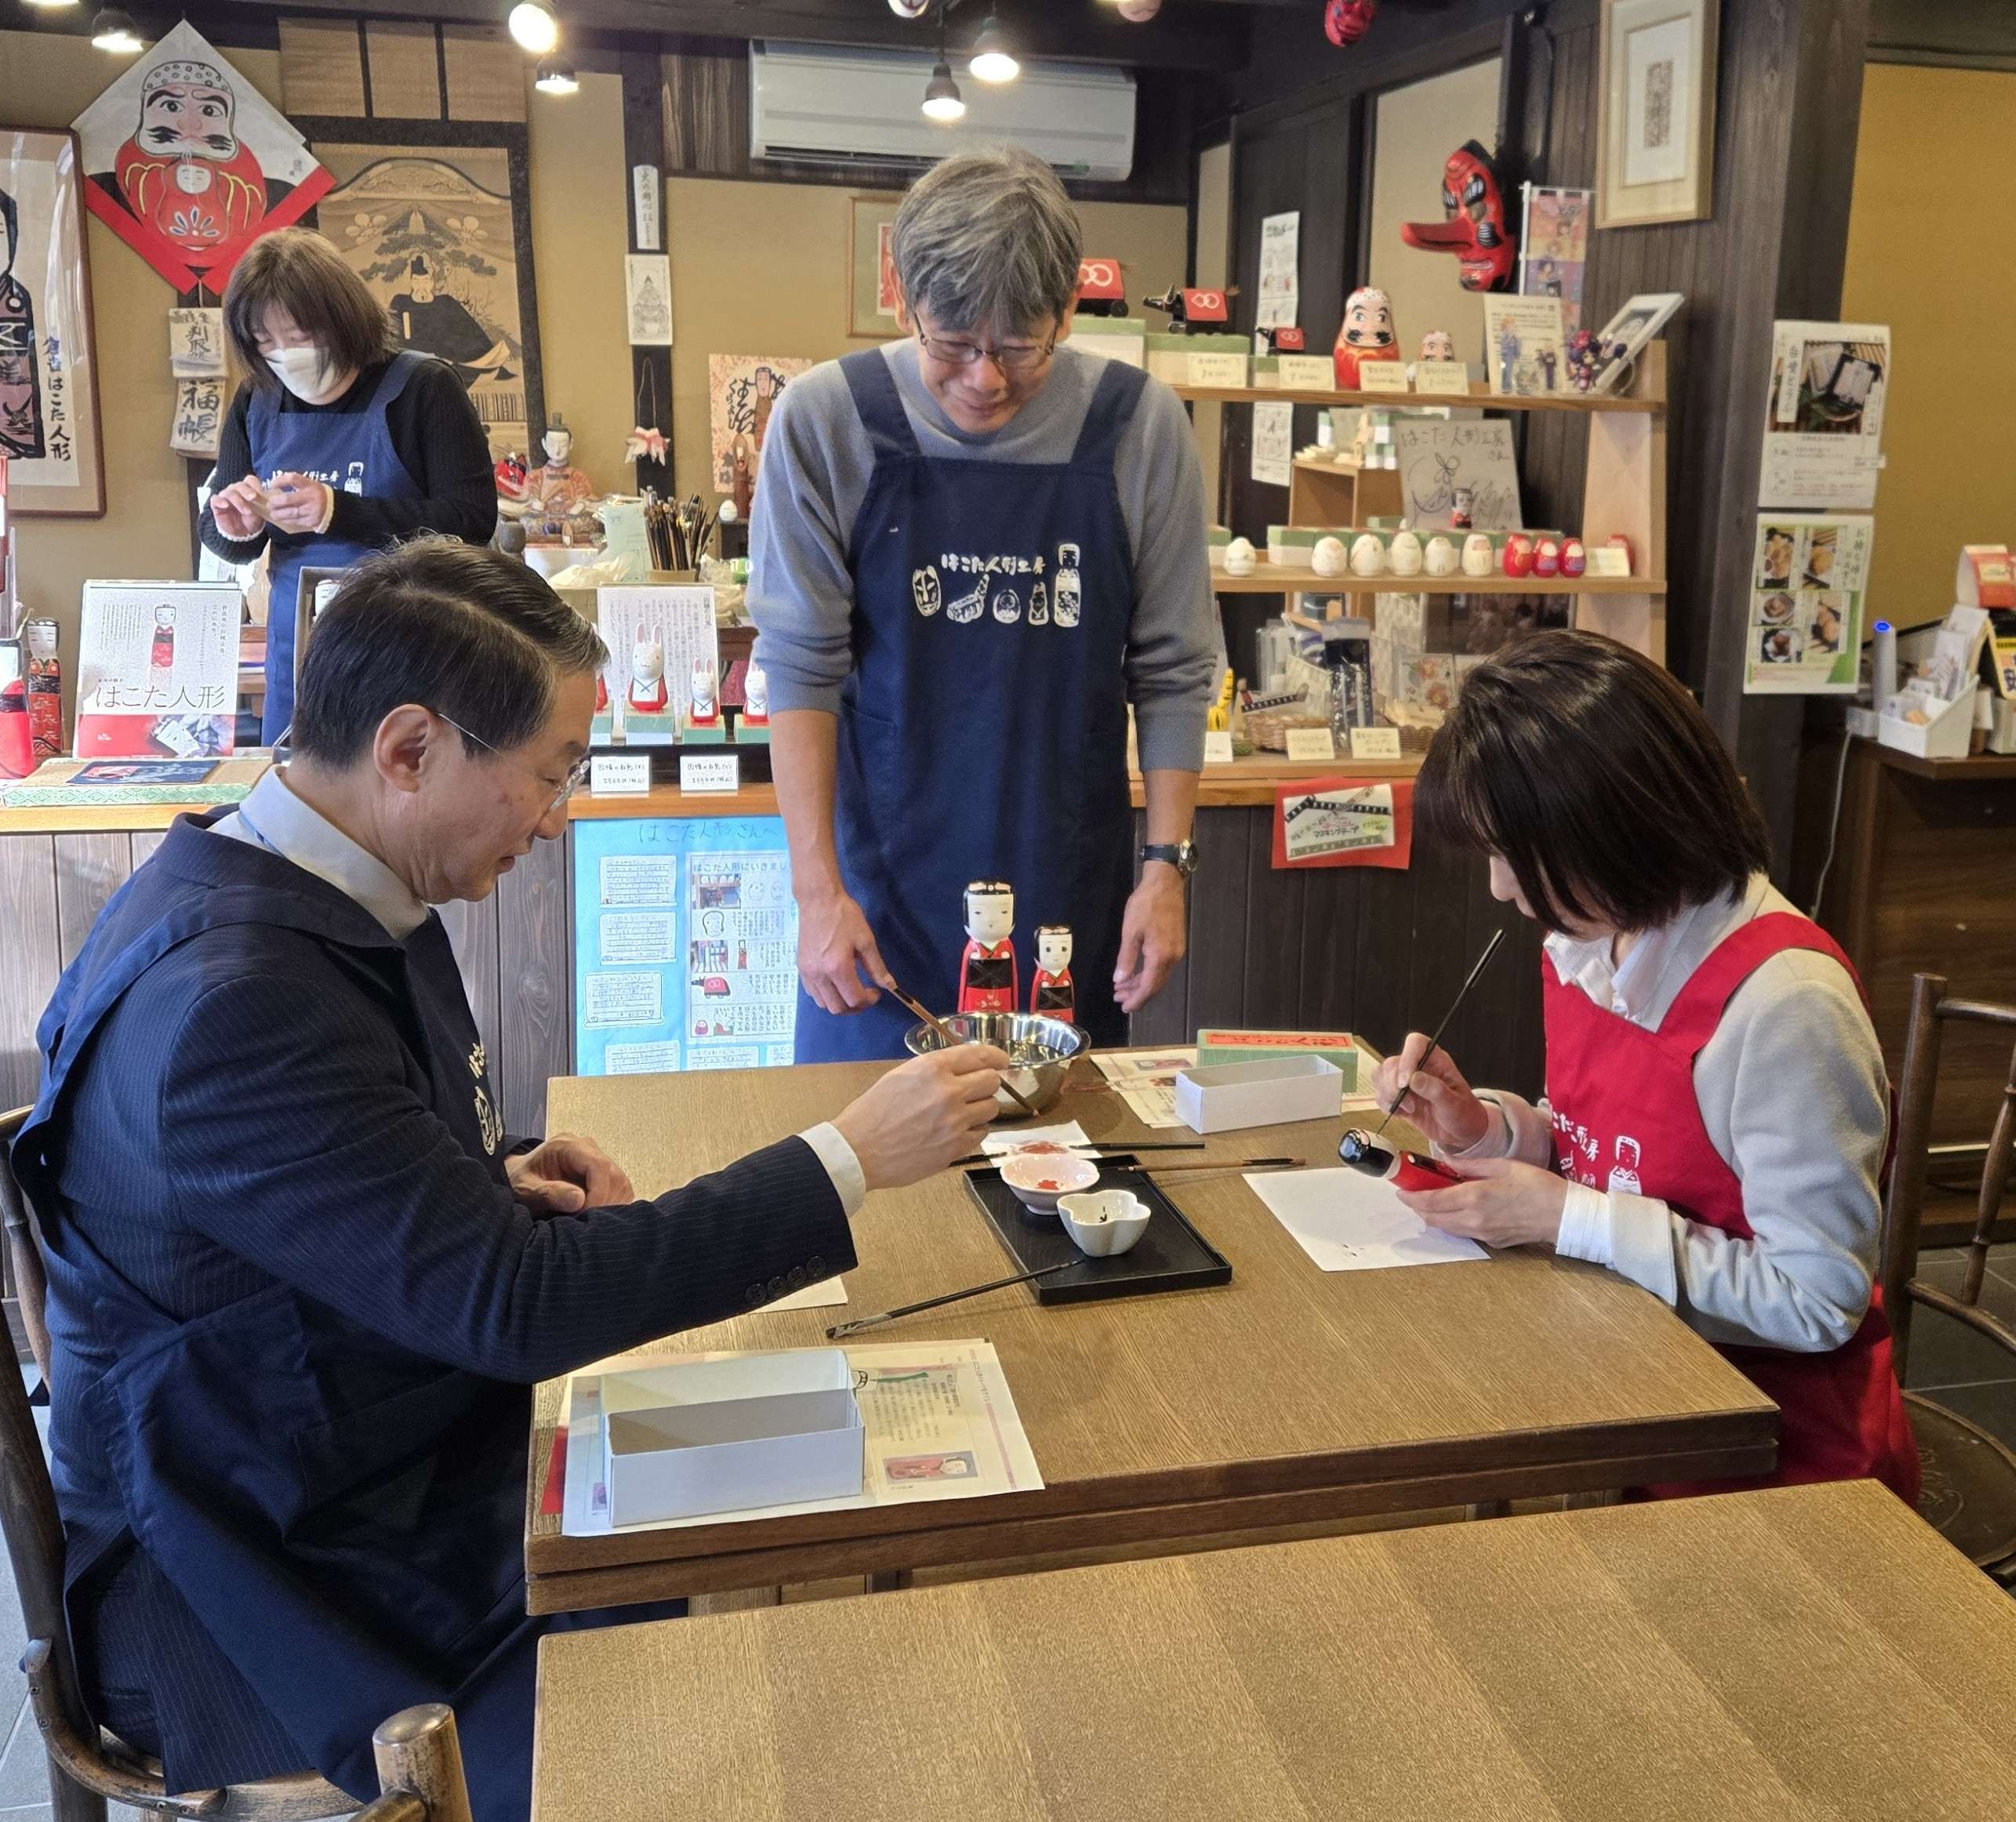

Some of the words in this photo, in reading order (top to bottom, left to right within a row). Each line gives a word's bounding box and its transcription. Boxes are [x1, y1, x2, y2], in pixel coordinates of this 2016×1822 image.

[96, 684, 225, 709] はこた人形
